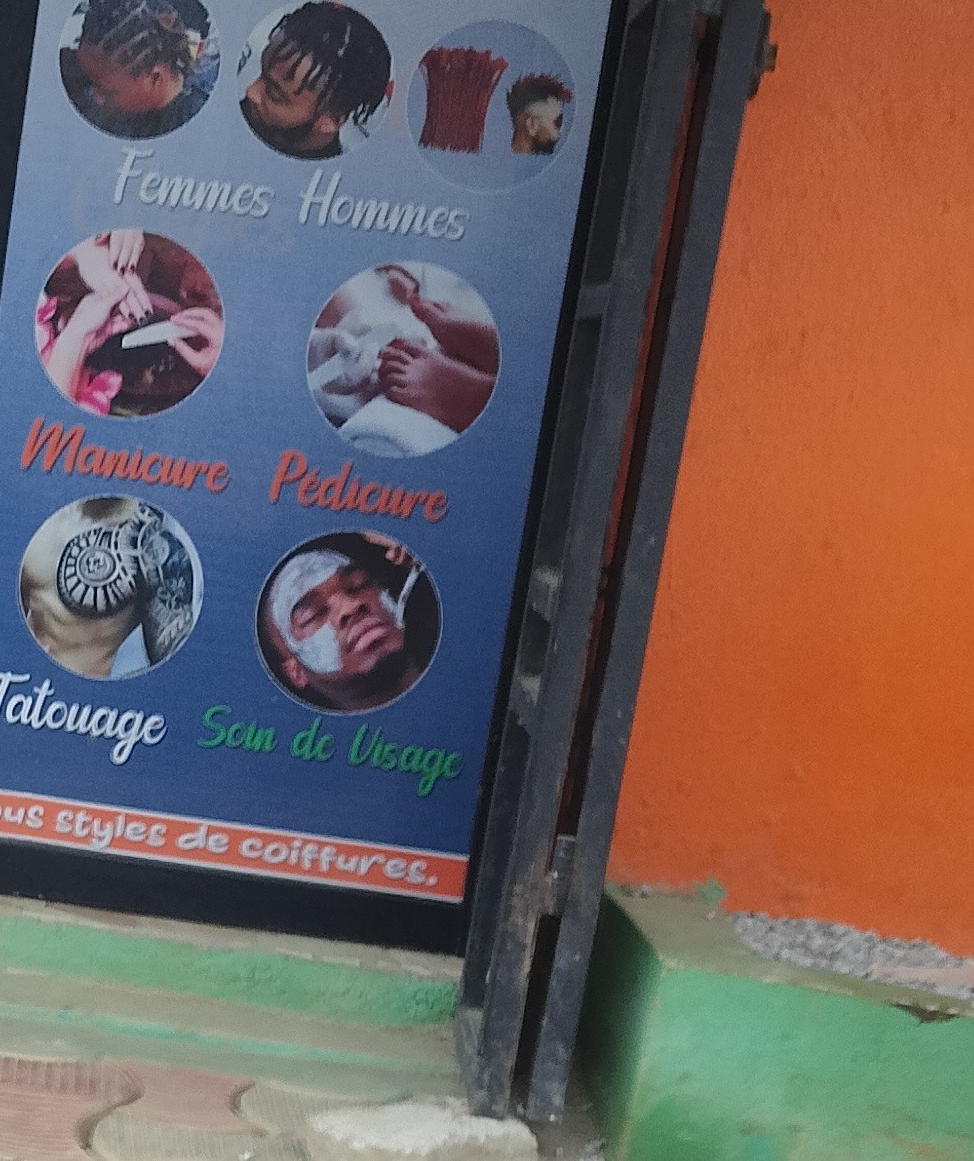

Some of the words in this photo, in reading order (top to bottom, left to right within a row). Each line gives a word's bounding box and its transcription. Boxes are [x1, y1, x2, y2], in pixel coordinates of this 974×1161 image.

[114, 148, 276, 219] Femmes
[298, 169, 472, 241] Hommes
[20, 415, 231, 493] Manicure
[196, 704, 278, 753] Soin
[289, 715, 336, 763] de
[347, 722, 464, 799] Visage
[55, 808, 166, 852] styles
[177, 822, 230, 855] de
[238, 836, 439, 888] coiffures.
